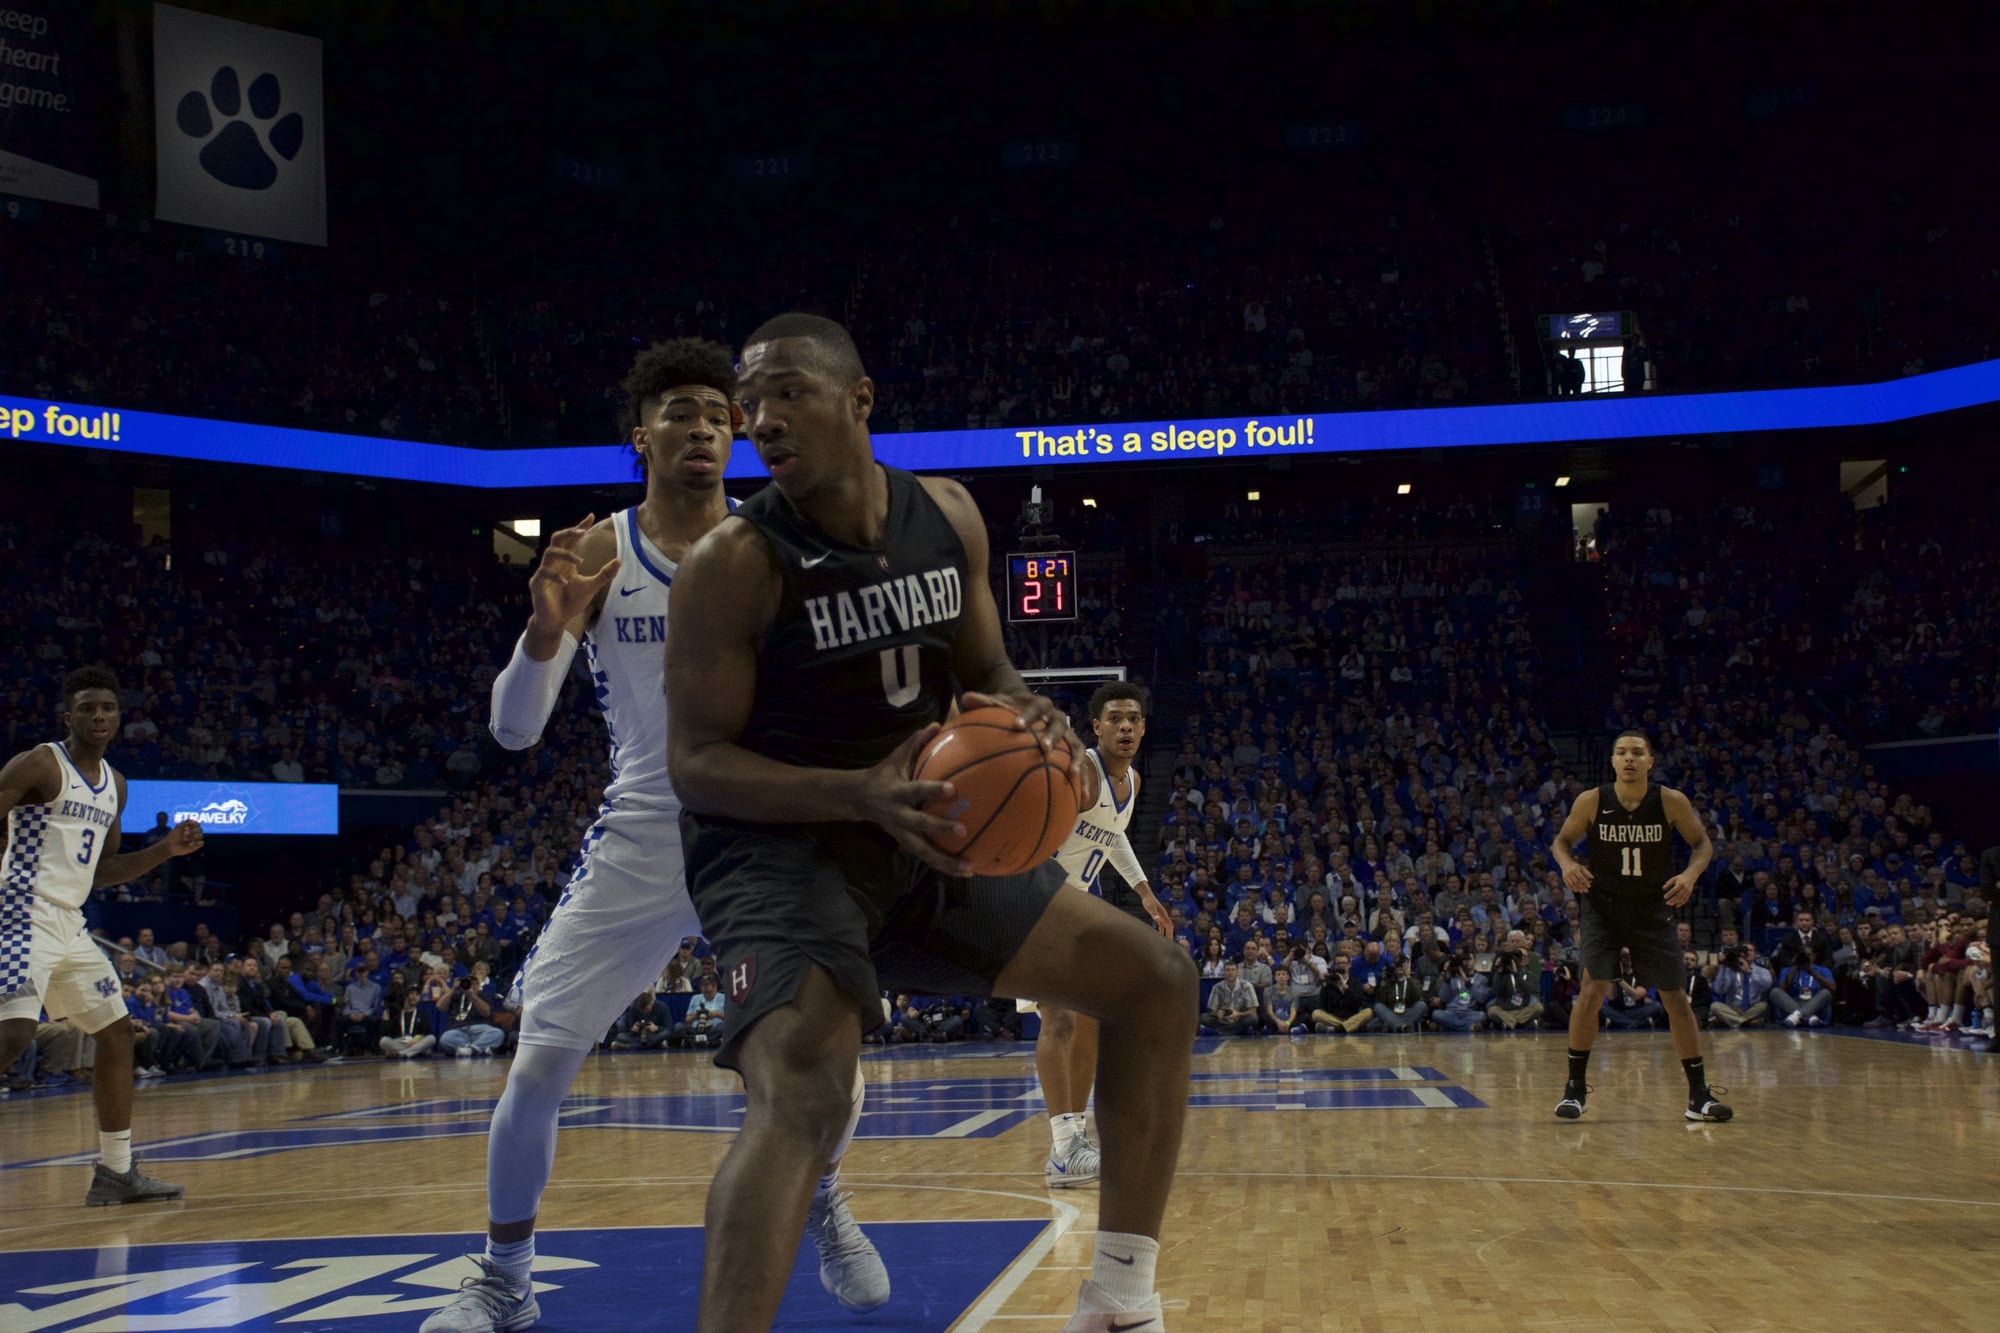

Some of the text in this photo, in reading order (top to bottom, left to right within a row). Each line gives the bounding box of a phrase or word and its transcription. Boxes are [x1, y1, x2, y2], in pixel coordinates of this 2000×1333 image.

[0, 38, 61, 76] heart
[0, 82, 71, 112] game.
[1307, 125, 1346, 144] 223
[1023, 143, 1060, 161] 223
[223, 238, 265, 260] 219
[43, 405, 121, 443] foul!
[1015, 418, 1314, 457] That's a sleep foul!
[804, 566, 962, 651] HARVARD
[1023, 580, 1064, 614] 21
[615, 615, 666, 643] KEN
[879, 643, 922, 708] 0
[61, 799, 115, 828] KENTUCK
[174, 811, 248, 825] #TRAVELKY
[77, 828, 95, 865] 3
[1075, 820, 1116, 847] KENTU
[1598, 823, 1663, 843] HARVARD
[1081, 849, 1104, 883] 0
[1620, 846, 1643, 877] 11
[731, 962, 749, 997] H
